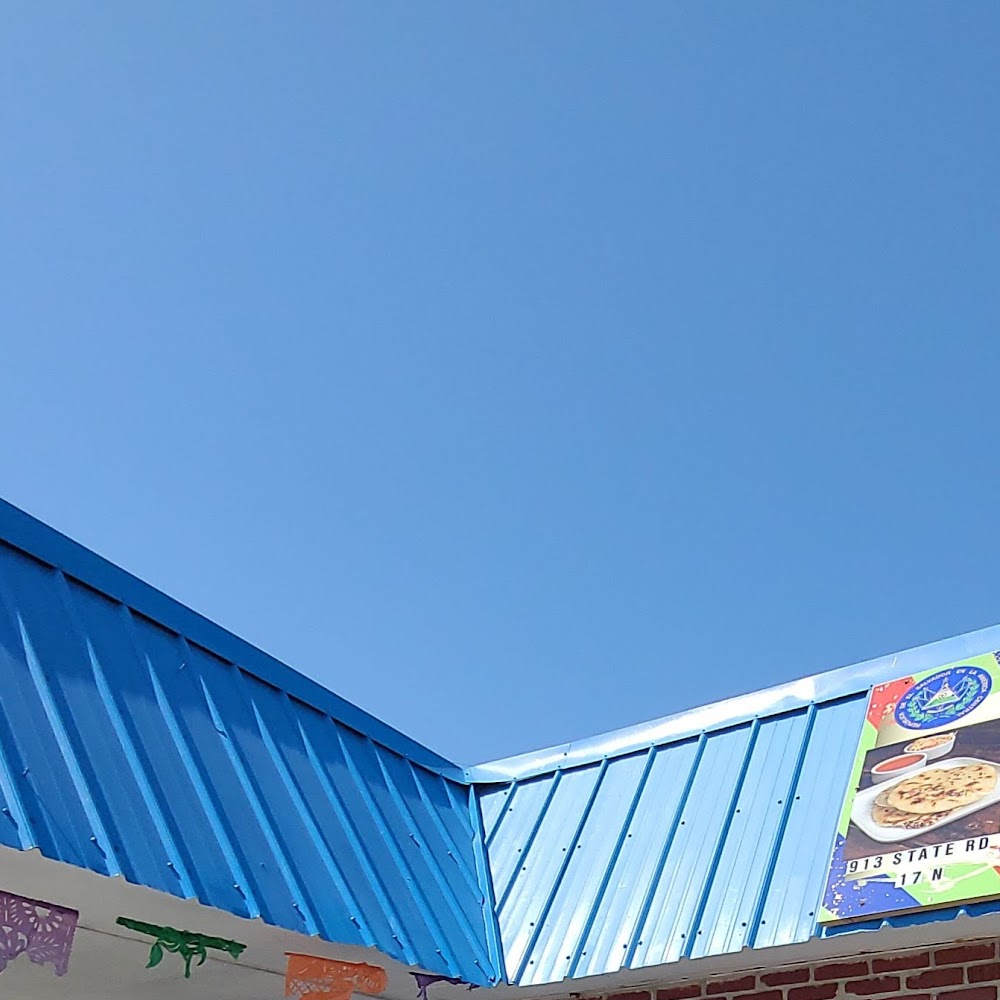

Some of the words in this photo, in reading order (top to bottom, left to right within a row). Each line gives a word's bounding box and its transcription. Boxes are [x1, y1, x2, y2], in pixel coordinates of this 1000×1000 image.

[848, 856, 884, 874] 913
[892, 842, 955, 866] STATE
[965, 836, 990, 852] RD
[900, 871, 923, 887] 17
[931, 867, 944, 882] N
